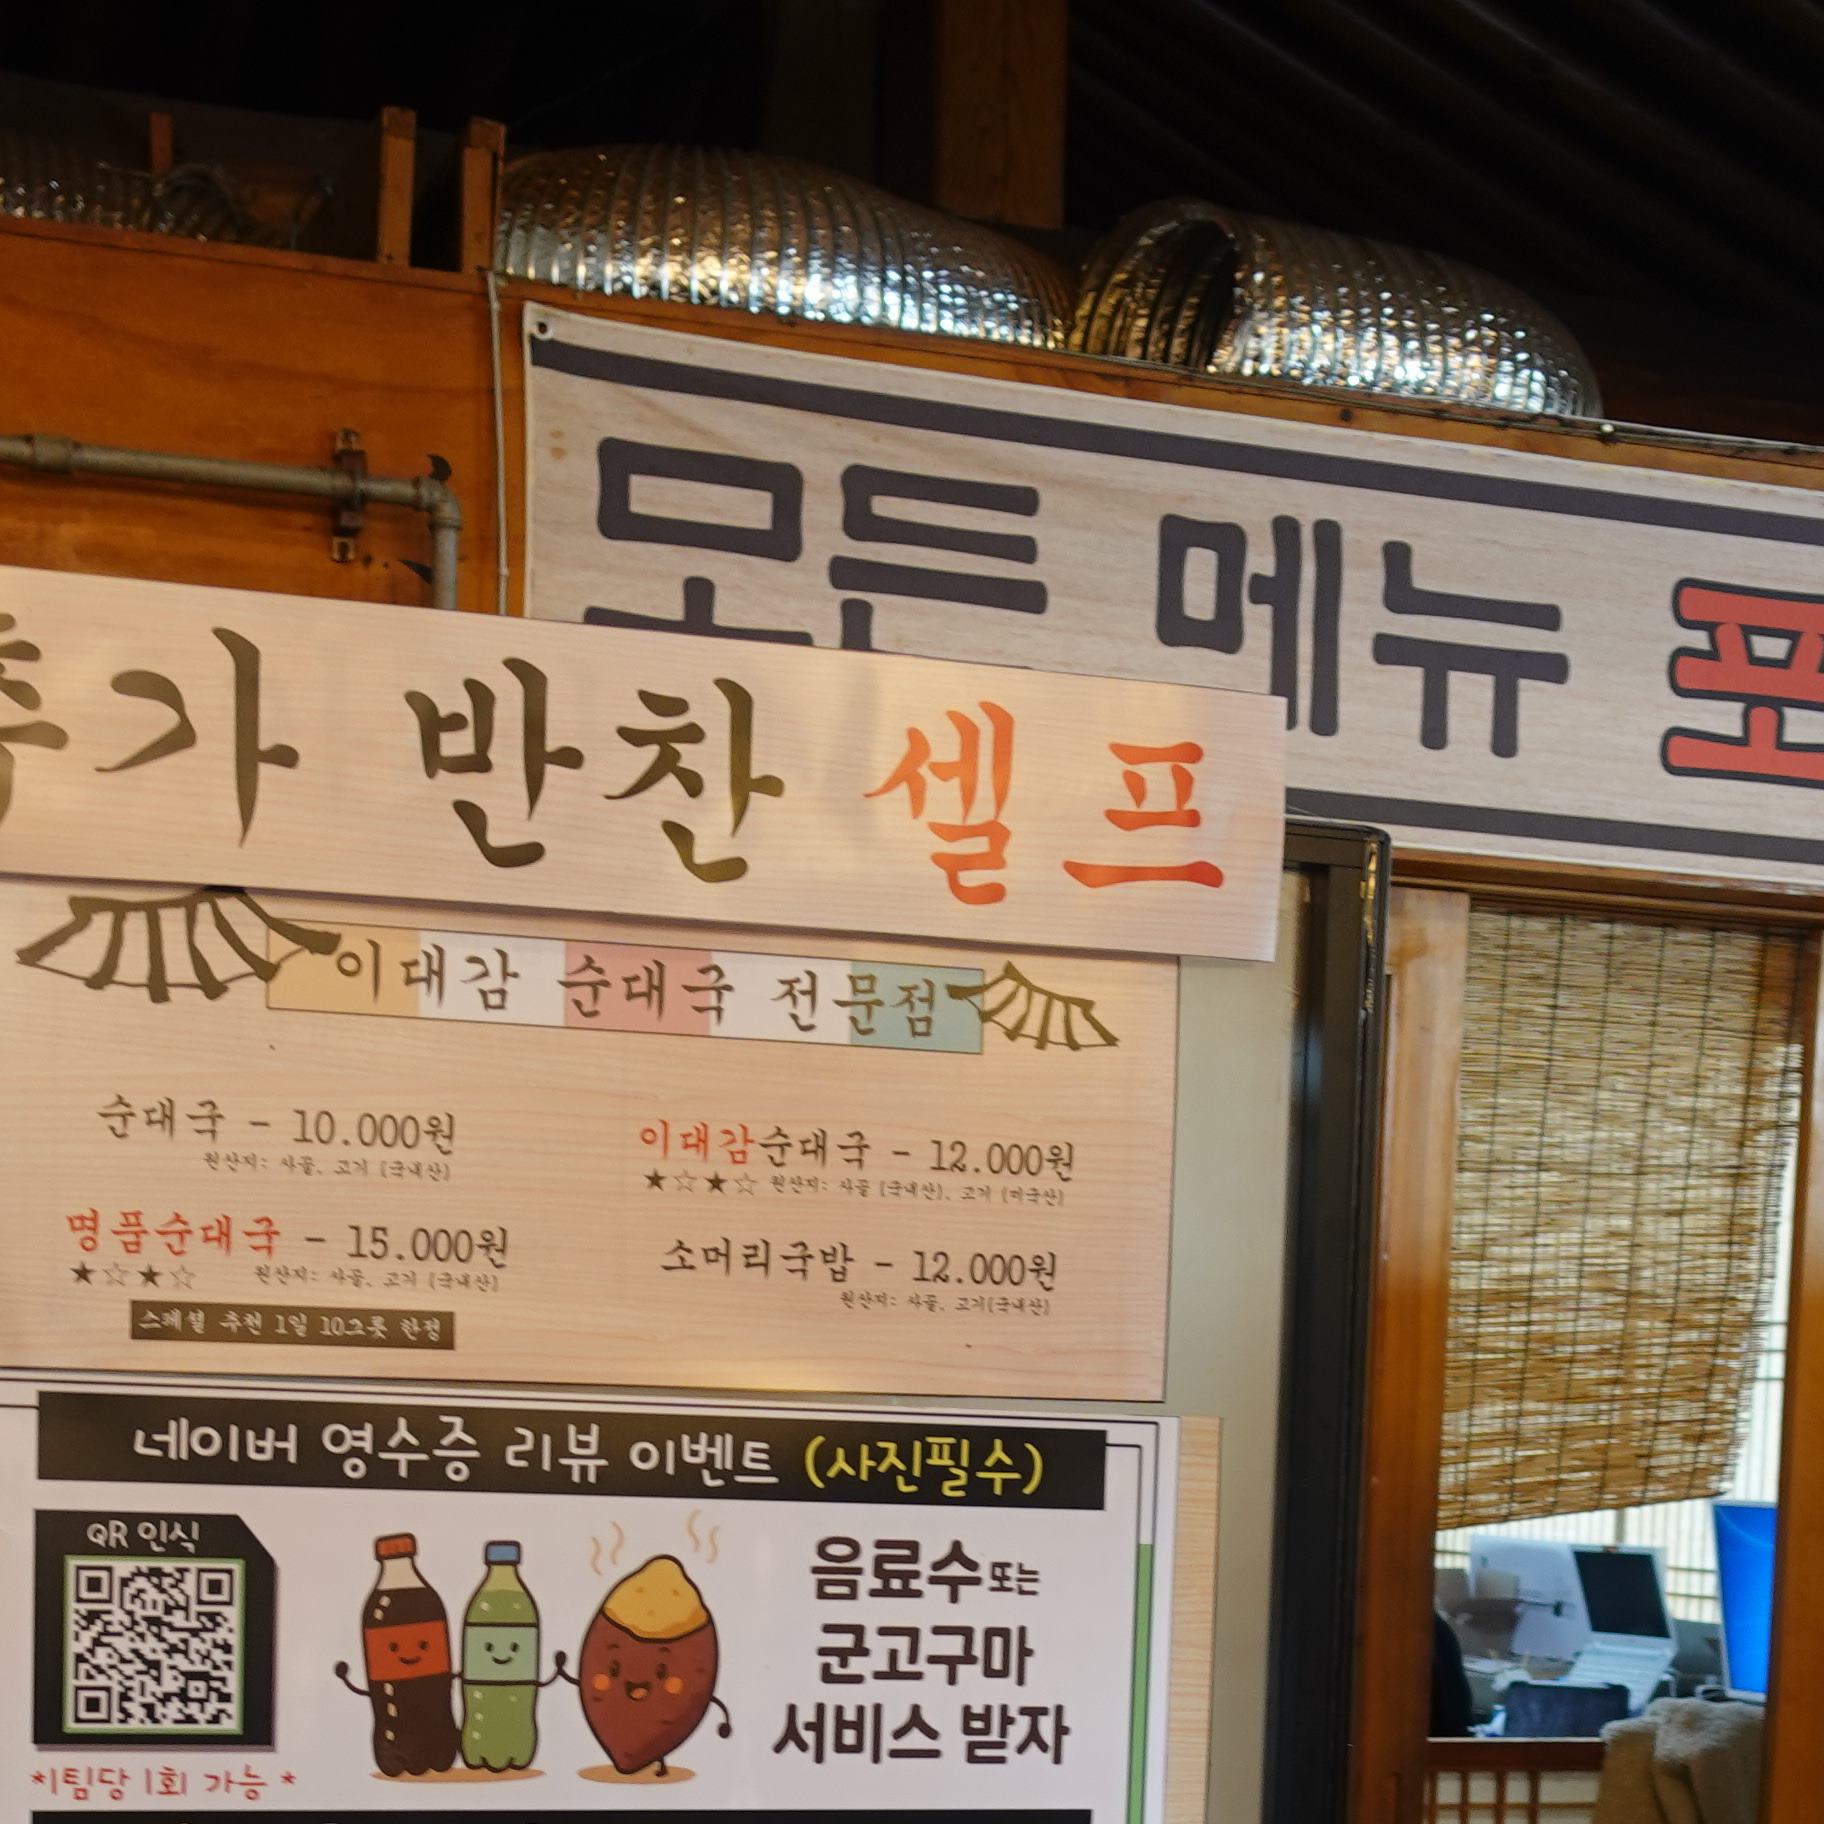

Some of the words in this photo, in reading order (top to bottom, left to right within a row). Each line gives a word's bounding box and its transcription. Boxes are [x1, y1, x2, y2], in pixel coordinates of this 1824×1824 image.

[1156, 510, 1570, 758] 메뉴
[405, 657, 785, 886] 반찬
[862, 700, 1226, 907] 셀프
[335, 938, 520, 1013] 이대감
[556, 954, 734, 1025] 순대국
[772, 969, 936, 1040] 전문점
[96, 1093, 226, 1144] 순대국
[291, 1108, 458, 1157] 10.000원
[639, 1118, 872, 1171] 이대감순대국
[928, 1139, 1076, 1183] 12.000원
[65, 1207, 281, 1260] 명품순대국
[346, 1223, 510, 1270] 15.000원
[660, 1237, 855, 1285] 소머리국밥
[911, 1249, 1058, 1294] 12.000원
[274, 1312, 308, 1338] 1일
[319, 1314, 389, 1340] 10그릇
[132, 1416, 299, 1465] 네이버
[321, 1414, 482, 1484] 영수증
[503, 1422, 610, 1485] 리뷰
[629, 1432, 780, 1489] 이벤트
[804, 1434, 1045, 1499] (사진필수)
[85, 1518, 130, 1550] QR
[137, 1519, 200, 1555] 인식
[810, 1535, 983, 1605] 음료수
[988, 1560, 1042, 1598] 또는
[816, 1622, 1035, 1687] 군고구마
[772, 1701, 943, 1765] 서비스
[960, 1702, 1072, 1766] 받자
[205, 1764, 268, 1801] 가능
